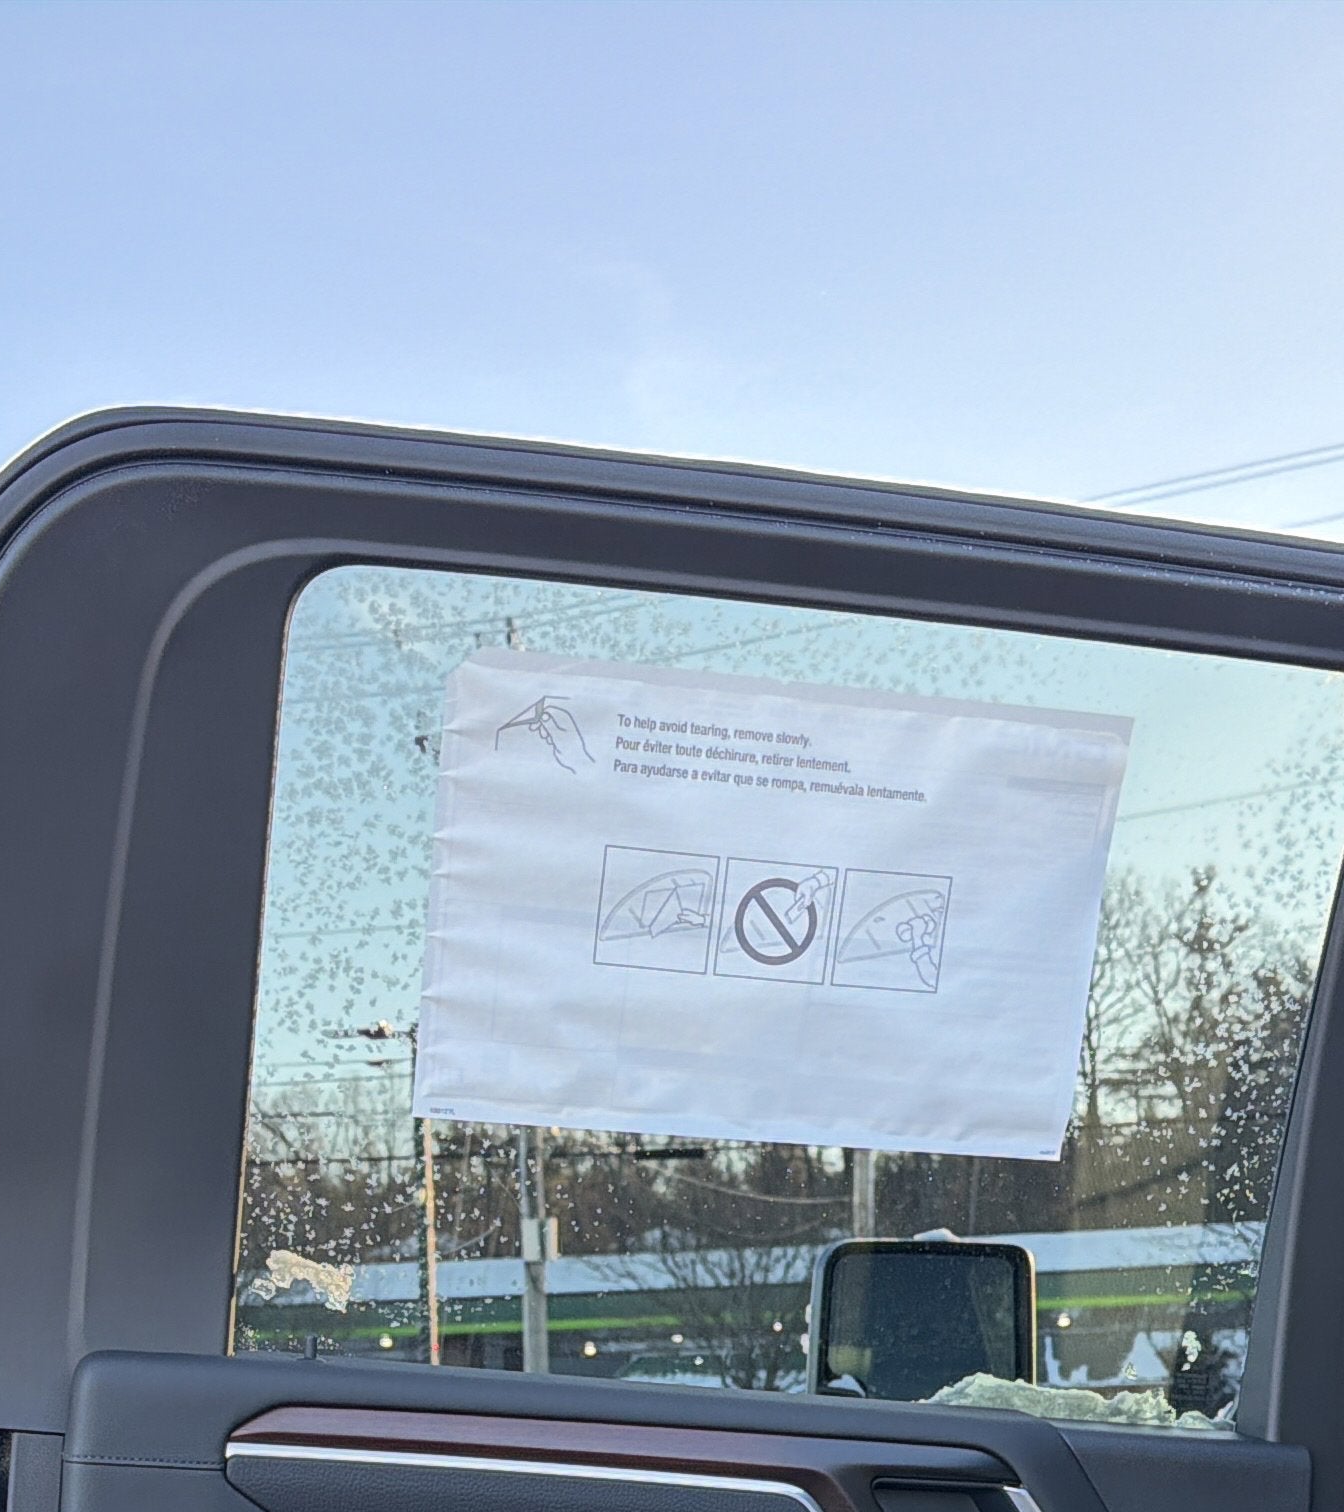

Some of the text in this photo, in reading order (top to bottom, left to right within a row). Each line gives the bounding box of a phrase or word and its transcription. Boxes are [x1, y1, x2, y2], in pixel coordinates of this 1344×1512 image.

[618, 714, 812, 749] To help avoid tearing, remove slowly.
[615, 736, 852, 773] Pour éviter toute déchirure, retirer lentement.
[613, 759, 927, 802] Para ayudarse a evitar que se rompa, remuévala lentamente.
